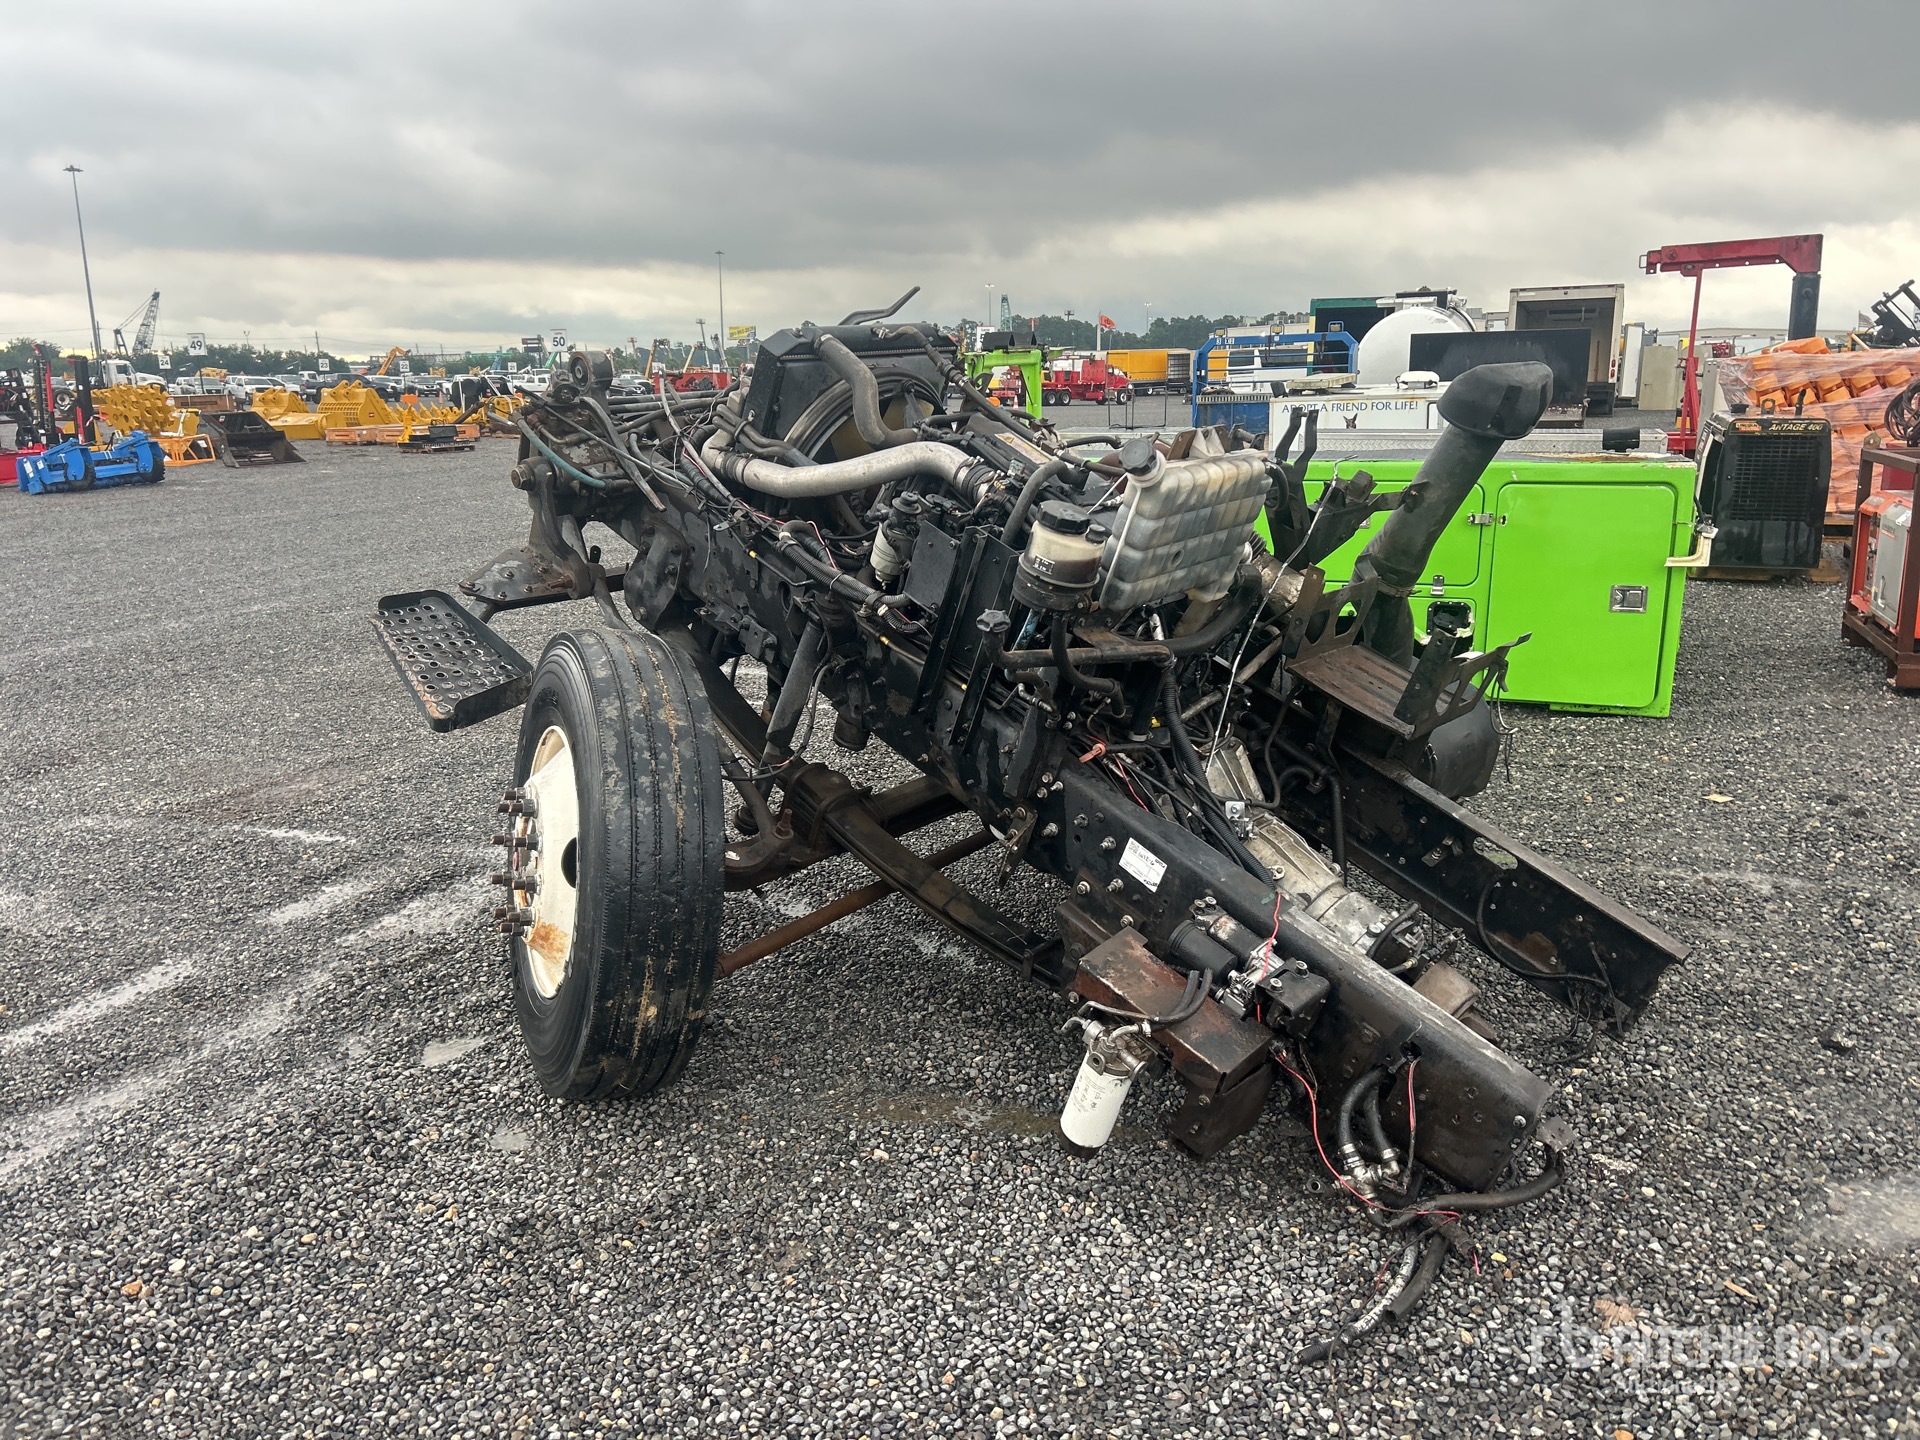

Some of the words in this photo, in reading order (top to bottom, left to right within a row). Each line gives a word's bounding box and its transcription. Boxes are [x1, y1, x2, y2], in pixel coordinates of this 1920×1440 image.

[190, 340, 203, 351] 49
[552, 336, 566, 347] 50
[1320, 403, 1328, 412] A
[1331, 402, 1368, 412] FRIEND
[1371, 401, 1392, 411] FOR
[1395, 401, 1418, 411] LIFE!
